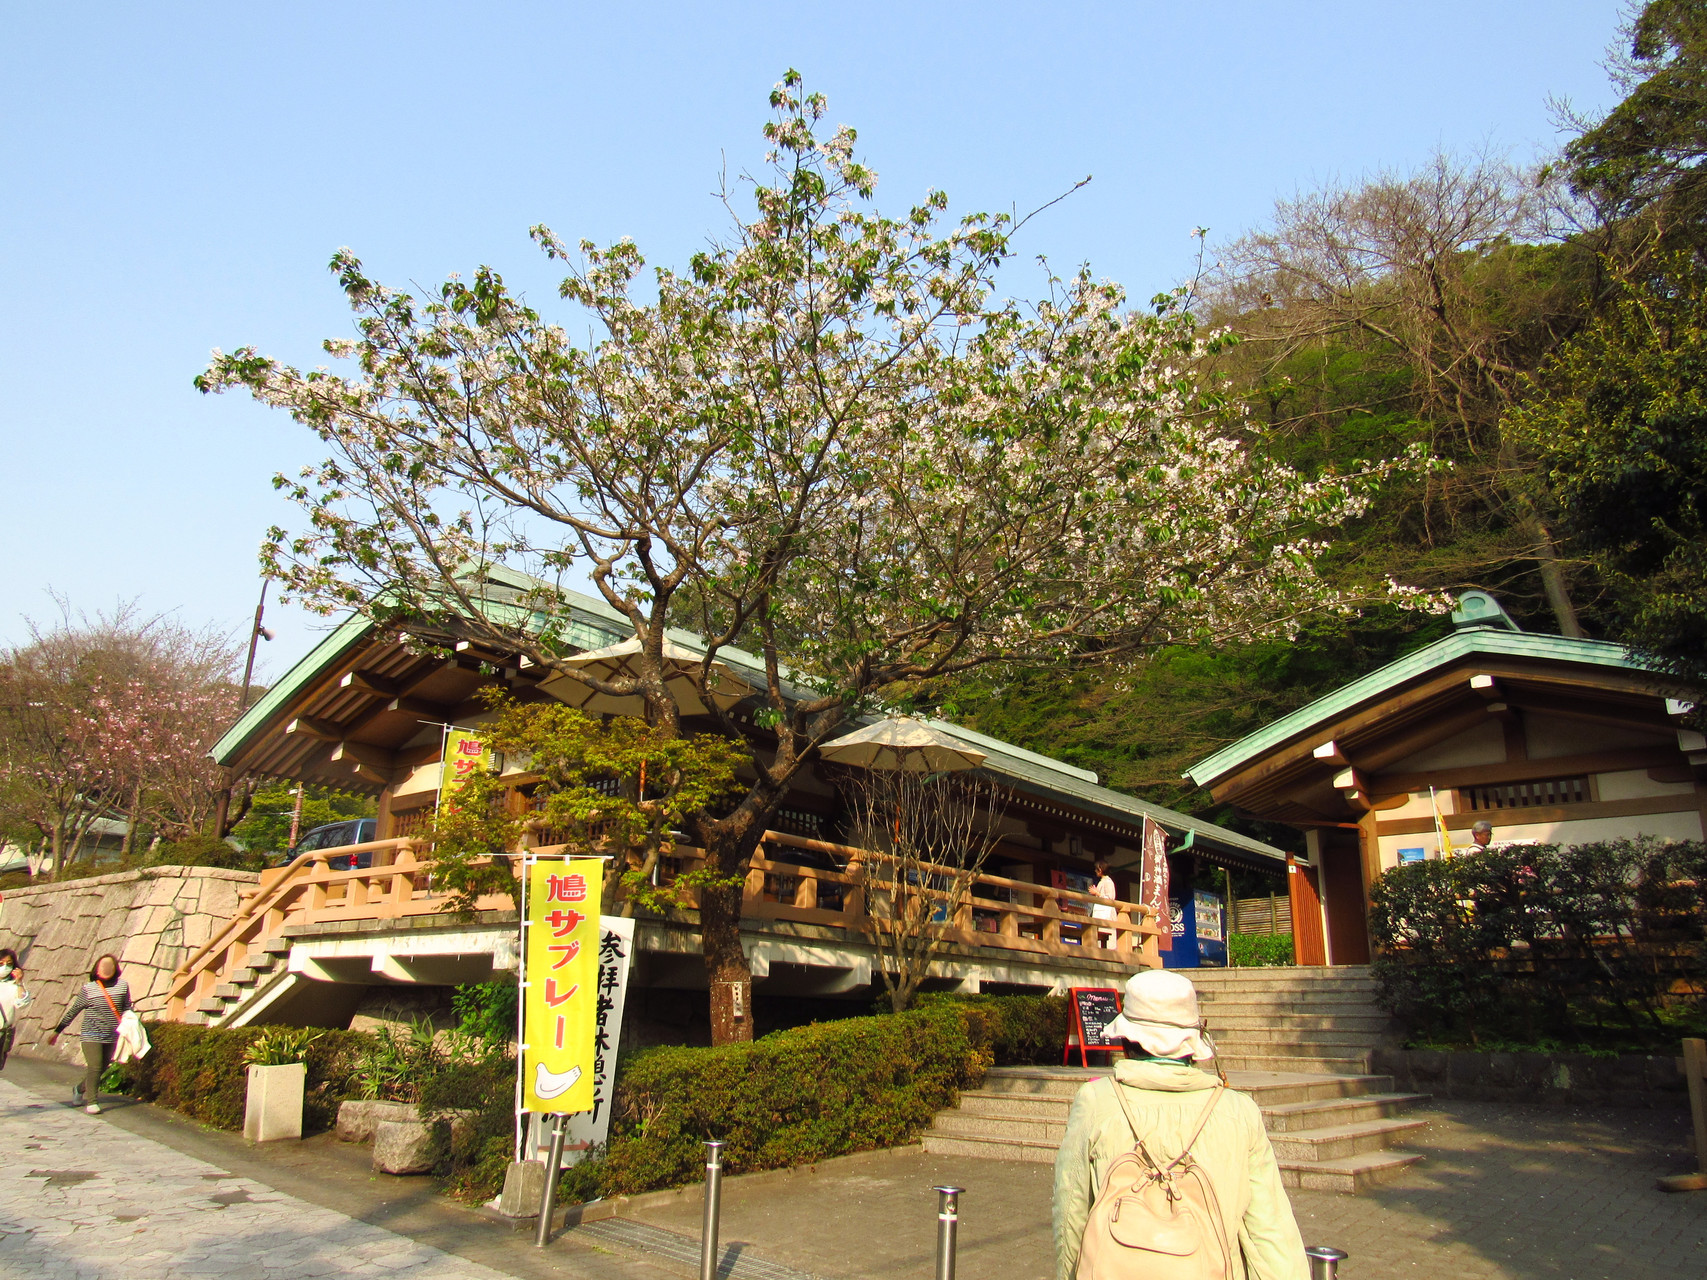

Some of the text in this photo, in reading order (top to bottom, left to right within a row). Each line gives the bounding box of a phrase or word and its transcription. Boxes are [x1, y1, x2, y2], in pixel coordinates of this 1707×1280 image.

[1170, 923, 1185, 932] OSS
[544, 873, 587, 1050] 鳩サブレー
[1086, 993, 1109, 1002] Menu
